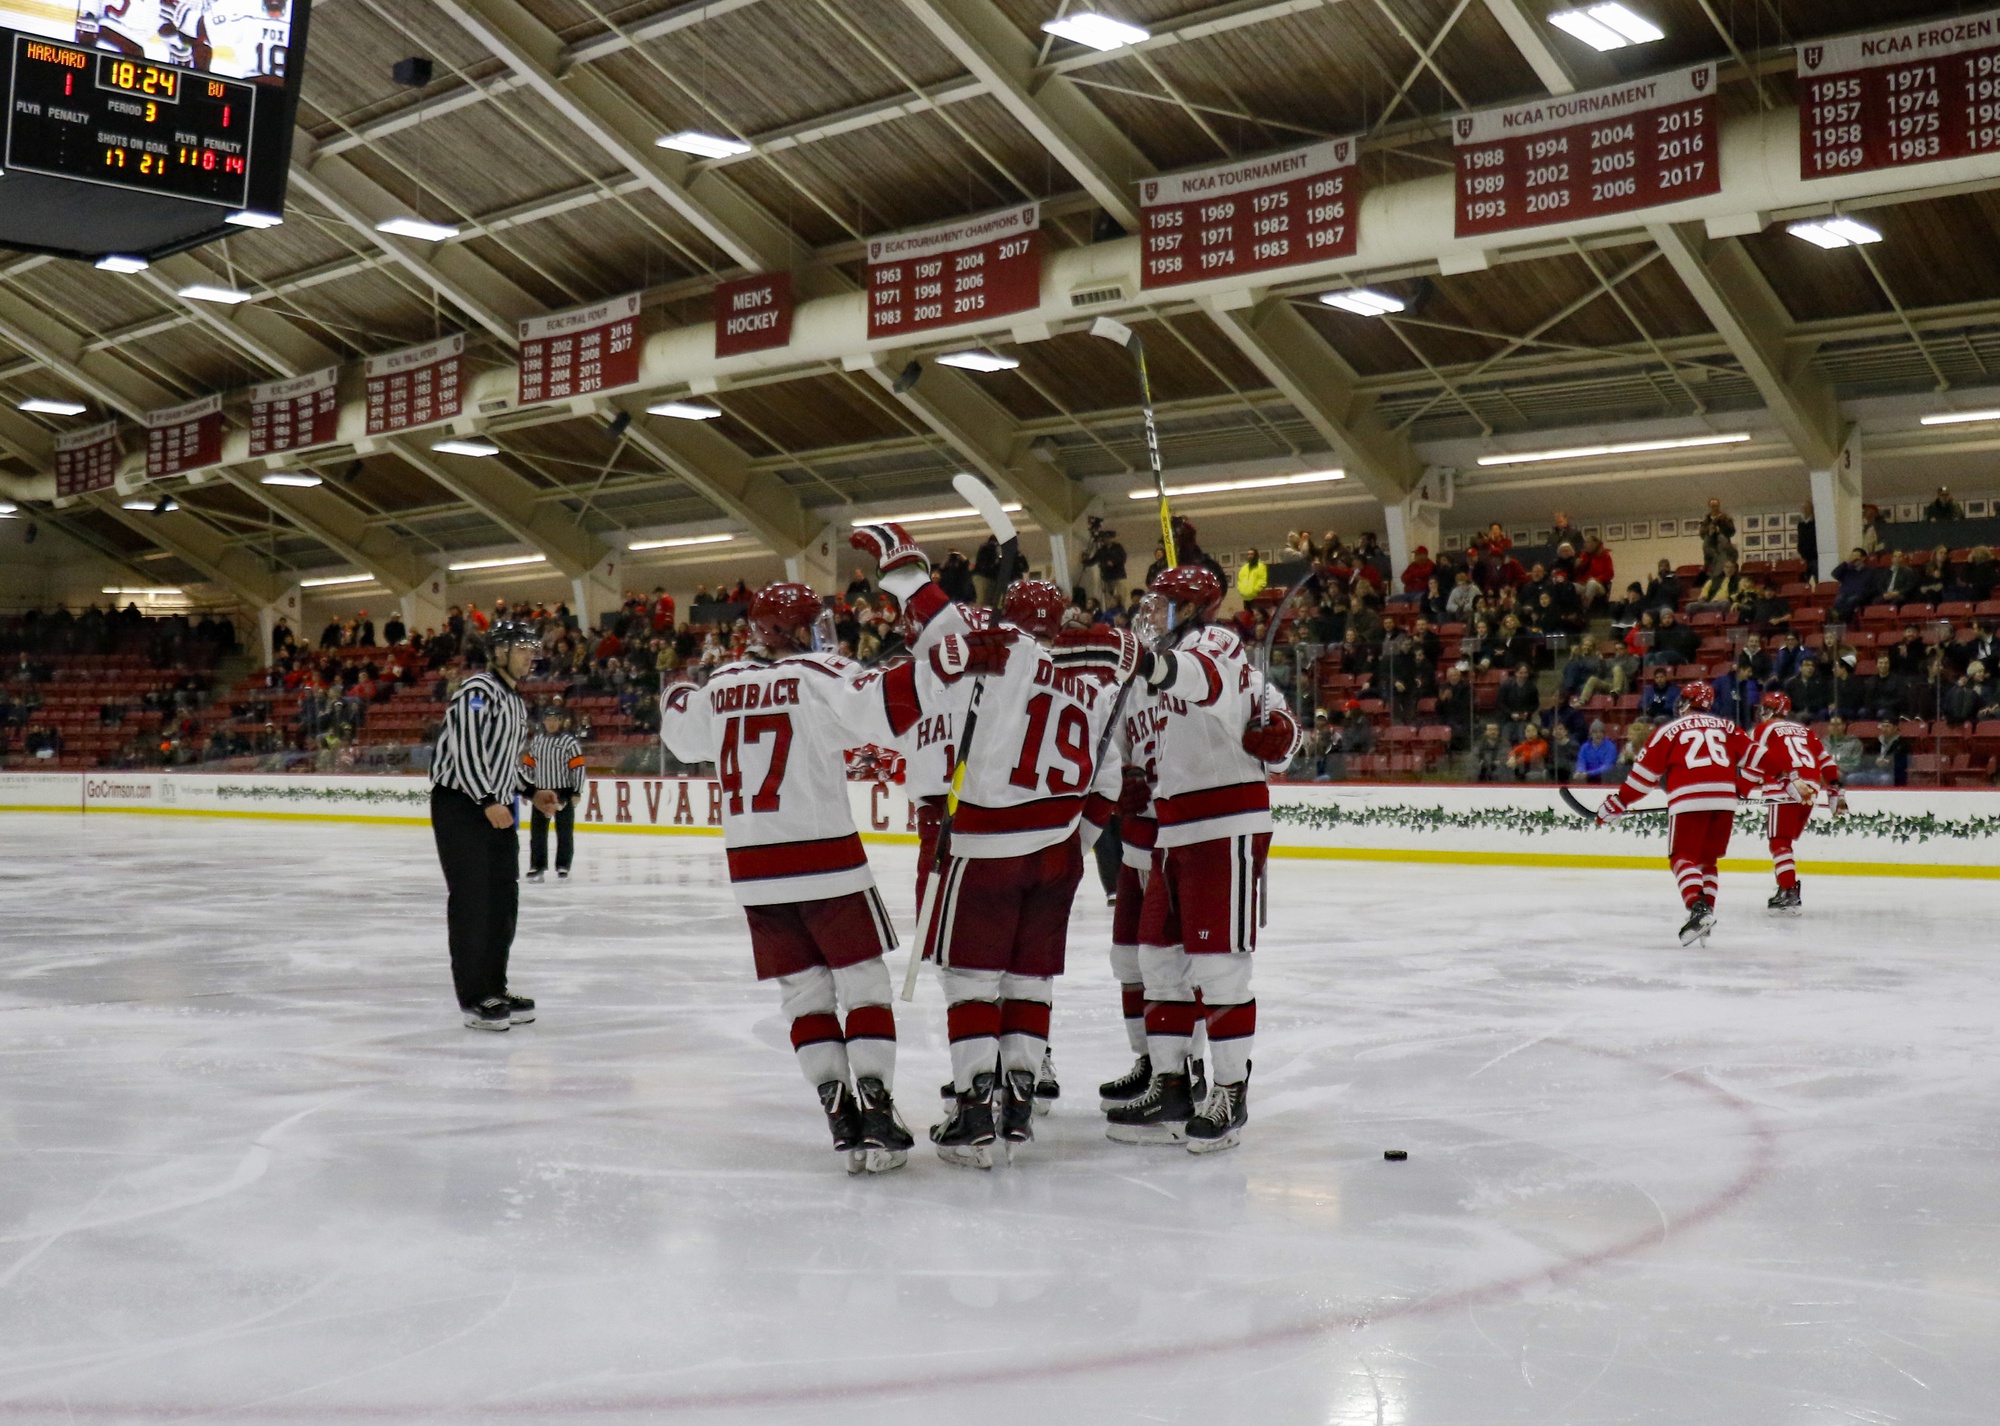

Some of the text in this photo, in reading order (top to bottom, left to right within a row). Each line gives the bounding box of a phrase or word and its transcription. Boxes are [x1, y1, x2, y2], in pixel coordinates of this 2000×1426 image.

[262, 28, 284, 42] FOX
[1861, 35, 1913, 57] NCAA
[1917, 18, 1991, 48] FROZEN
[27, 42, 86, 69] HARVARD
[64, 72, 73, 96] 1
[111, 62, 175, 96] 18:24
[208, 81, 226, 98] BU
[1812, 56, 2000, 103] 1955 1971 198
[16, 101, 90, 125] PLYR PENALTY
[108, 100, 157, 123] PERIOD 3
[222, 105, 230, 127] 1
[1502, 108, 1543, 128] NCAA
[1547, 83, 1657, 120] TOURNAMENT
[1812, 80, 2000, 125] 1957 1974 198
[1464, 108, 1703, 170] 1988 1994 2004 2015
[1812, 104, 2000, 148] 1958 1975 198
[97, 132, 170, 155] SHOTS ON GOAL
[175, 132, 242, 153] PLYR PENALTY
[179, 147, 198, 166] 11
[1813, 127, 2000, 171] 1969 1983 199
[105, 148, 165, 175] 17 21
[1182, 176, 1216, 193] NCAA
[1217, 154, 1308, 186] TOURNAMENT
[1465, 135, 1703, 196] 1989 2002 2005 2016
[1150, 178, 1343, 229] 1955 1969 1975 1985
[1466, 162, 1705, 221] 1993 2003 2006 2017
[885, 240, 906, 254] ECAC
[907, 230, 964, 249] TOURNAMENT
[965, 214, 1019, 238] CHAMPIONS
[1150, 202, 1344, 252] 1957 1971 1982 1986
[875, 240, 1030, 285] 1963 1987 2004 2017
[1150, 226, 1344, 275] 1958 1974 1983 1987
[733, 288, 773, 311] MEN'S
[874, 274, 983, 306] 1971 1994 2006
[727, 311, 779, 335] HOCKEY
[874, 295, 985, 327] 1983 2002 2015
[609, 337, 632, 354] 2017
[610, 323, 632, 339] 2016
[1037, 608, 1047, 618] 19
[1009, 692, 1093, 796] 19
[1679, 729, 1730, 770] 26
[1784, 737, 1816, 769] 15
[720, 712, 793, 816] 47
[87, 780, 151, 799] GoCrimson.com
